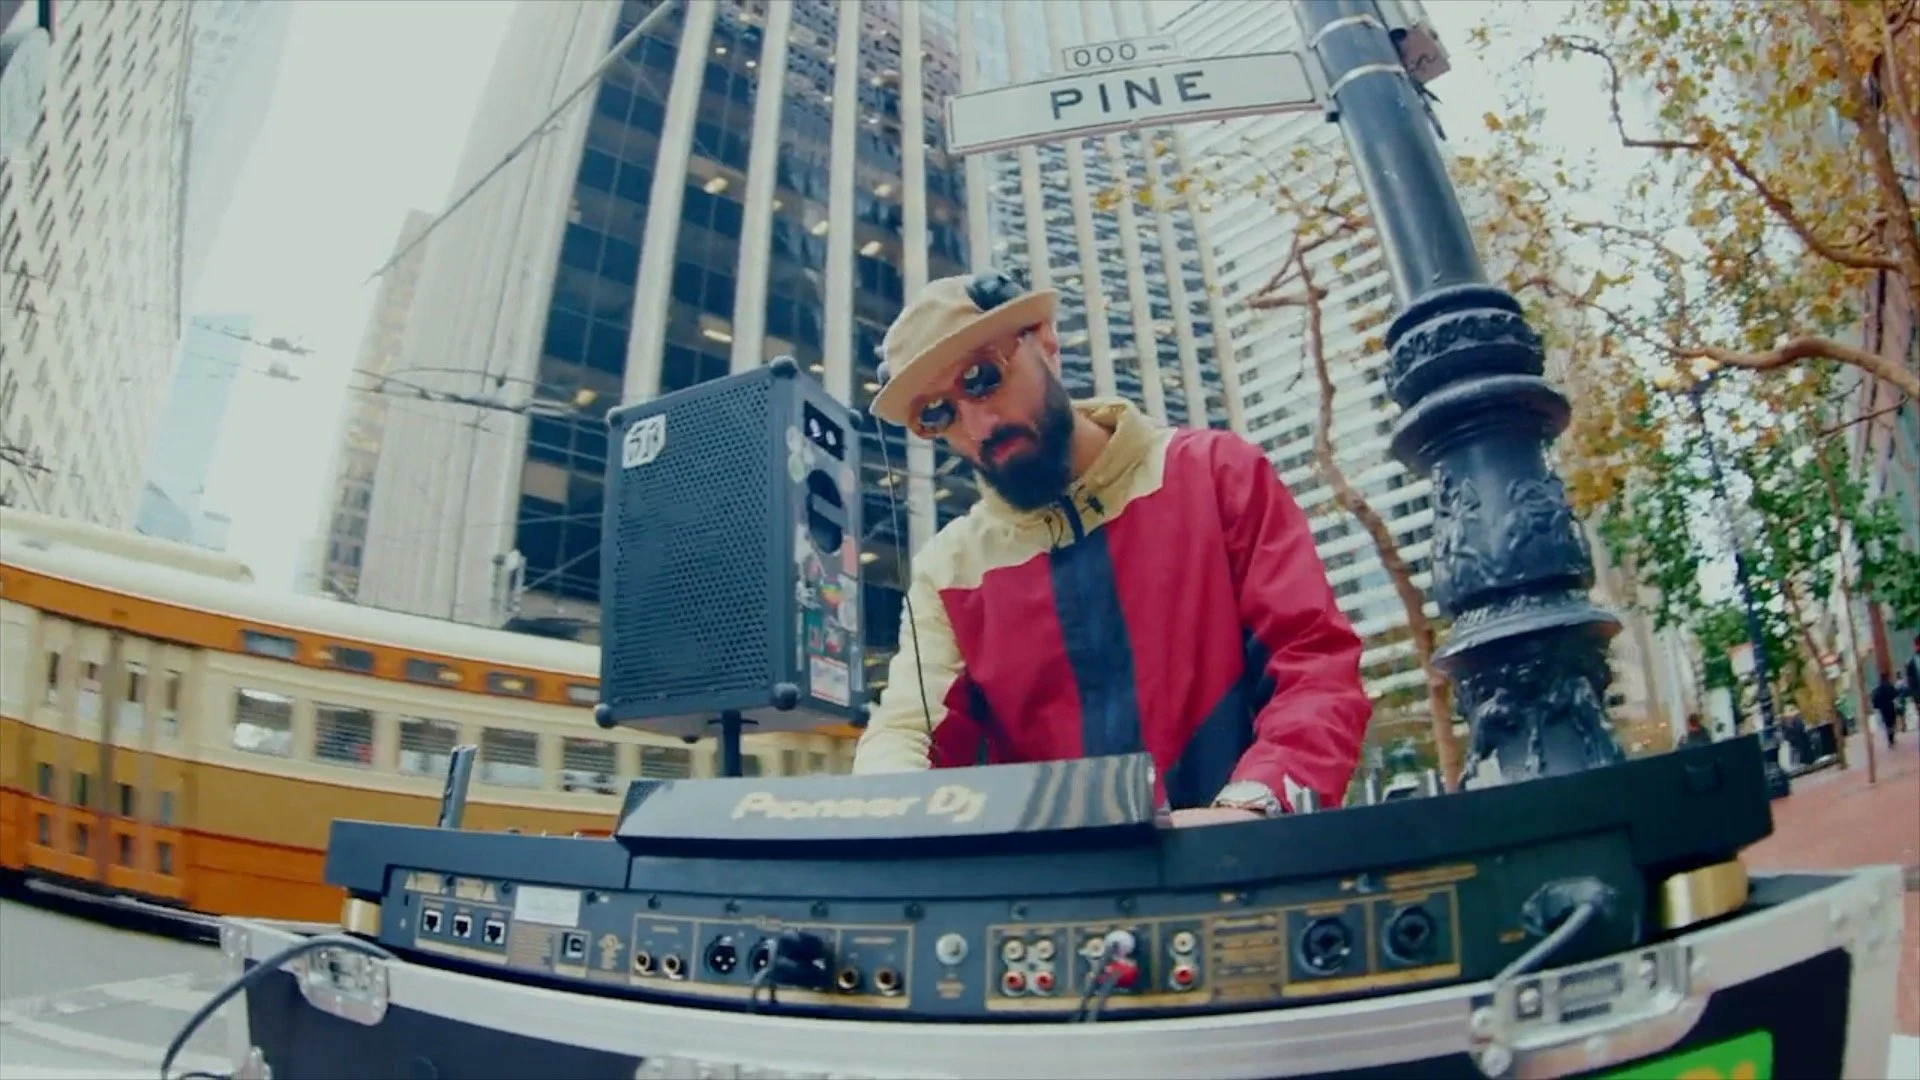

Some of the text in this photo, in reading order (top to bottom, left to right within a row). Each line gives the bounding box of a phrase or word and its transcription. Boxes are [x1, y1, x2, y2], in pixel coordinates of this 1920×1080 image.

[1074, 43, 1136, 67] 000
[1050, 70, 1211, 120] PINE
[731, 791, 921, 820] Pioneer
